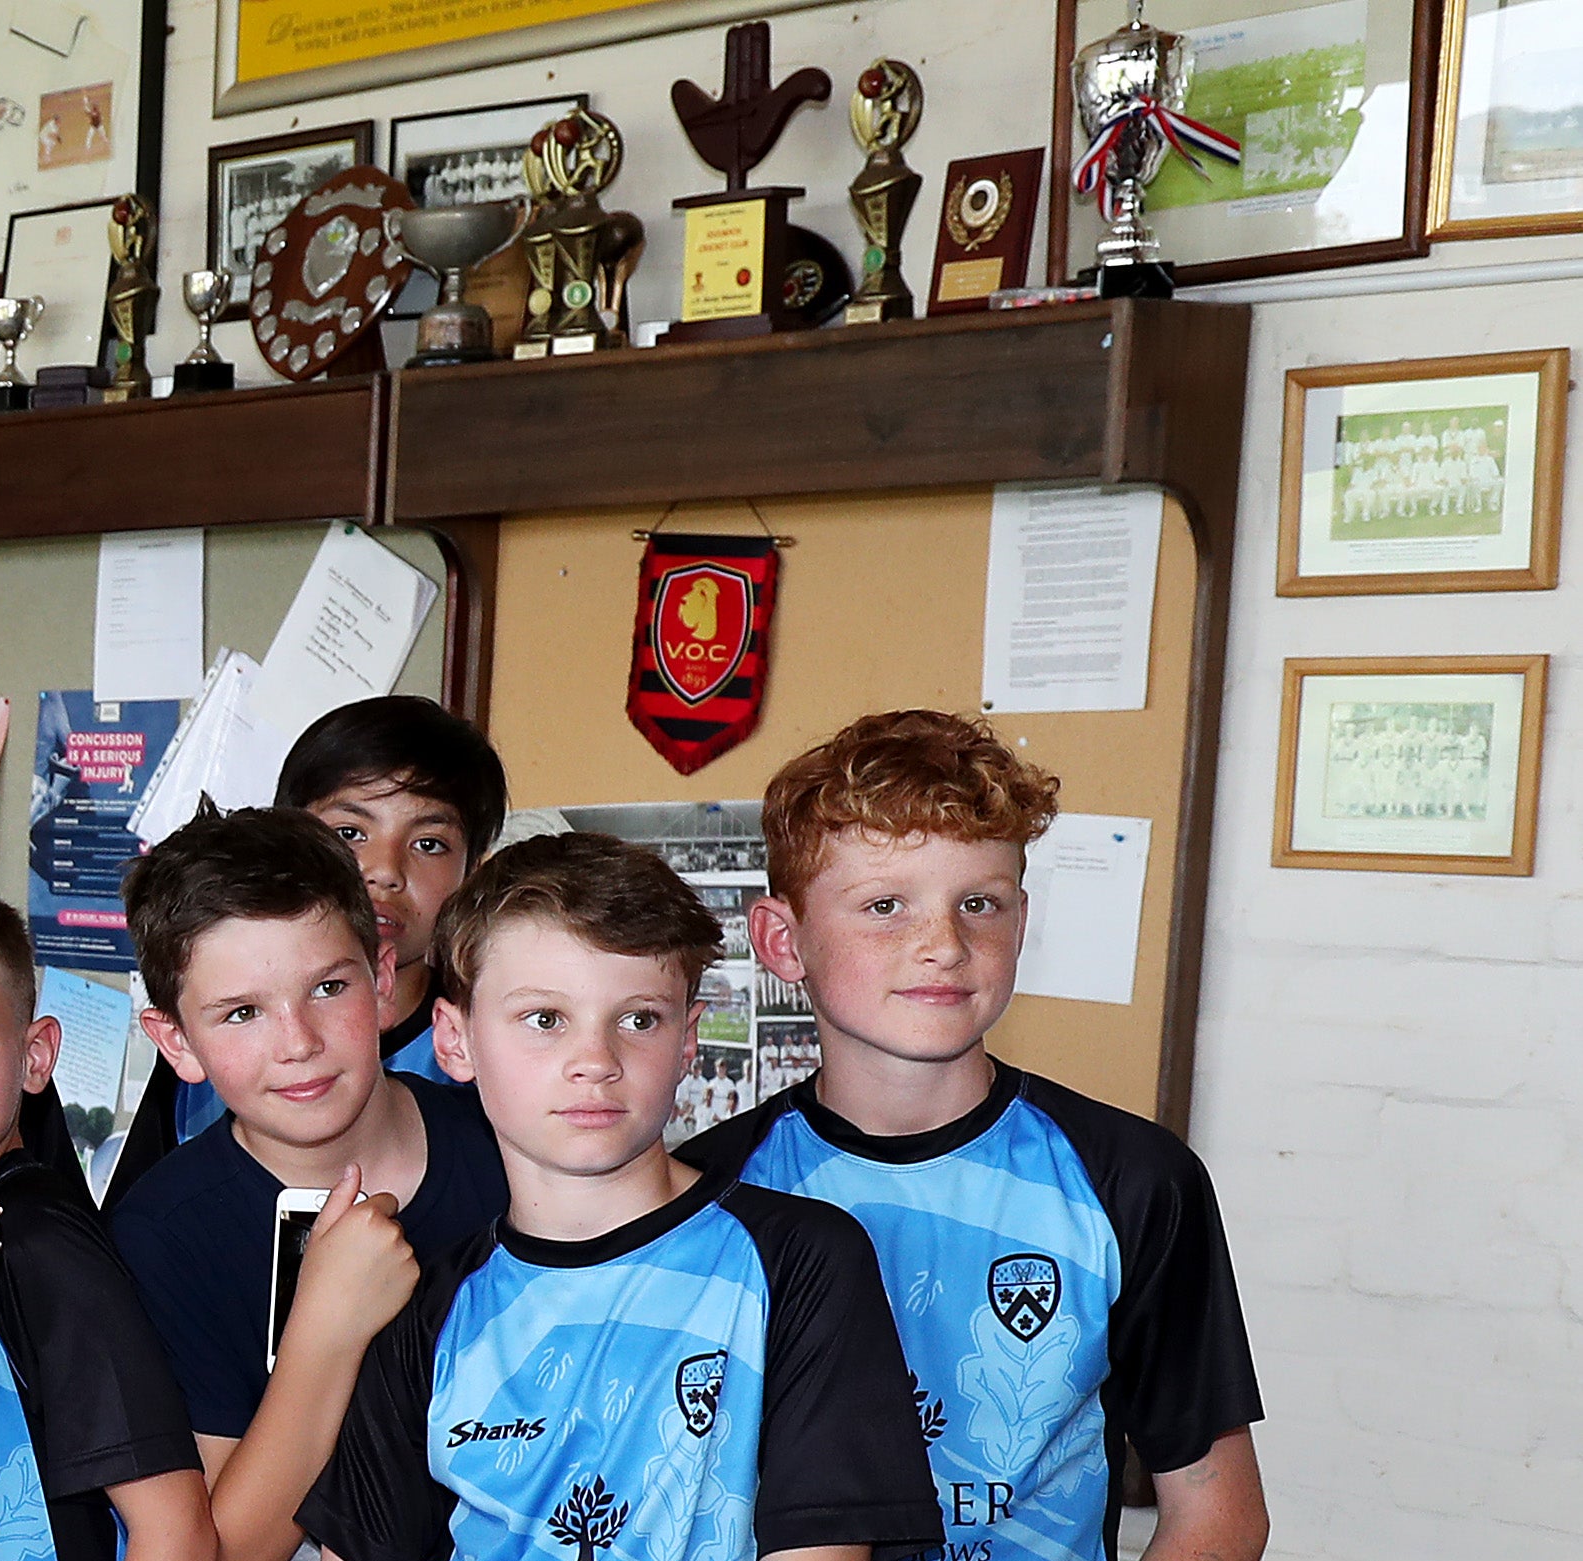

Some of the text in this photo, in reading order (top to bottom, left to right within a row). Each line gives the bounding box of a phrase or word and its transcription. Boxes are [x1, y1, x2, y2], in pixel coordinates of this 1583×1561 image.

[666, 641, 729, 662] V.O.C.
[69, 733, 143, 746] CONCUSSION
[69, 750, 142, 762] IS A SERIOUS
[83, 766, 125, 779] INJURY
[447, 1417, 548, 1449] Sharks
